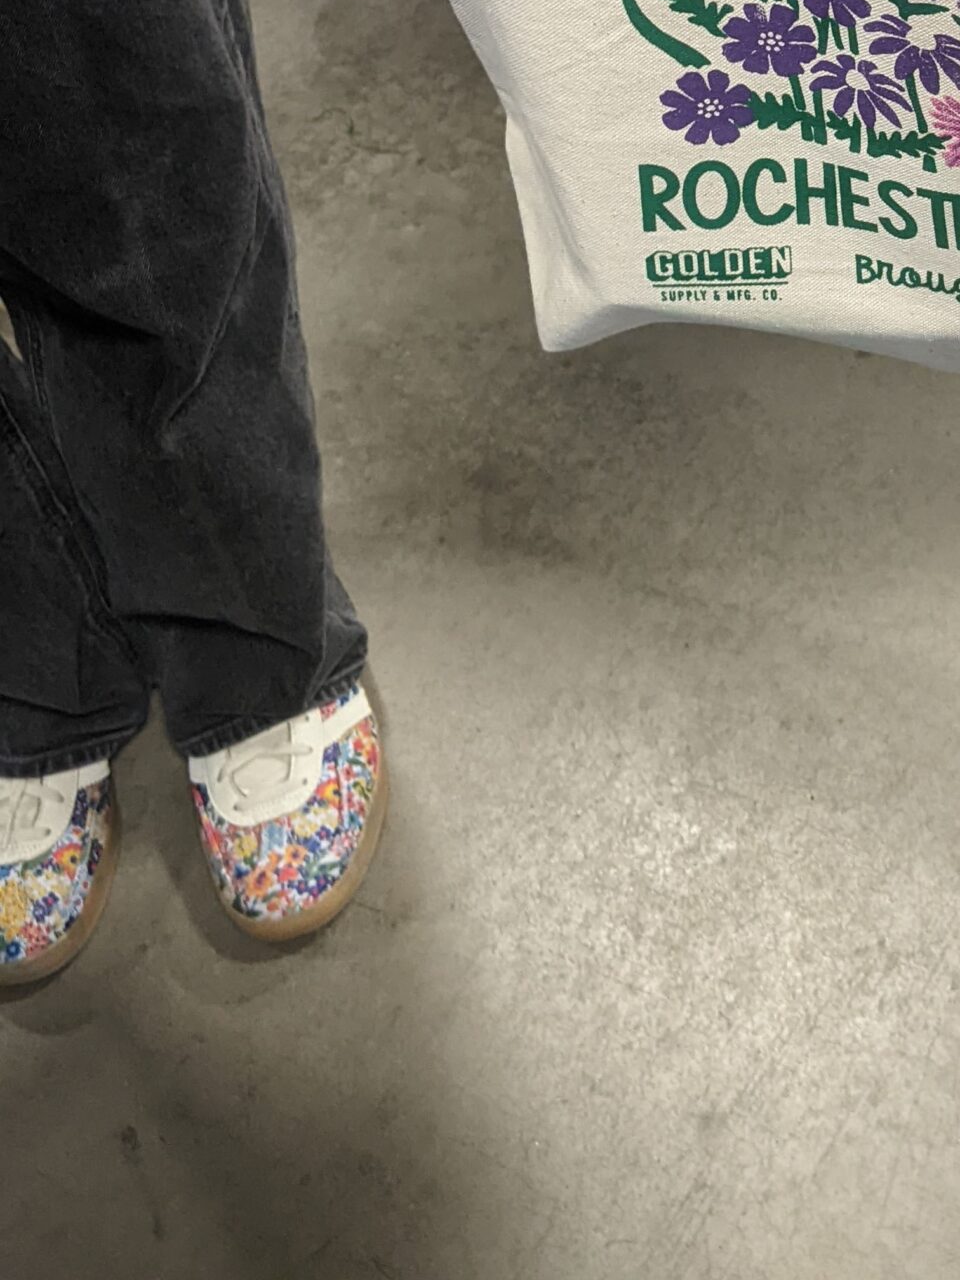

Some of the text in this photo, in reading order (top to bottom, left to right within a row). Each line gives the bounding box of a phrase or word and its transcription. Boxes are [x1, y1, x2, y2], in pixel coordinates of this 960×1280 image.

[646, 245, 793, 282] GOLDEN
[660, 288, 783, 302] SUPPLY & MFG. CO.
